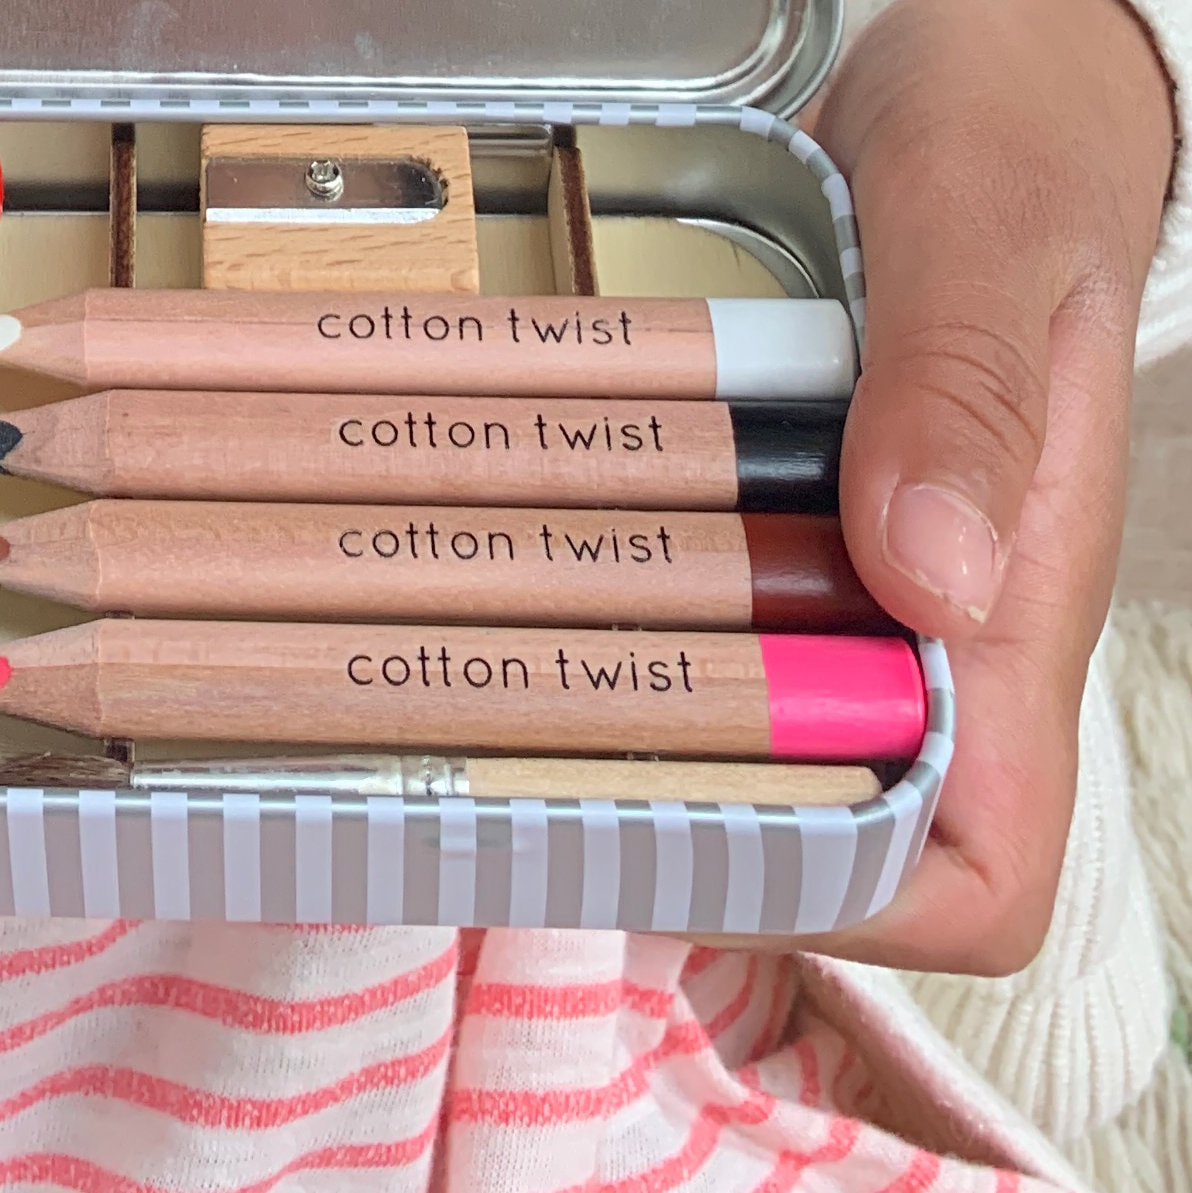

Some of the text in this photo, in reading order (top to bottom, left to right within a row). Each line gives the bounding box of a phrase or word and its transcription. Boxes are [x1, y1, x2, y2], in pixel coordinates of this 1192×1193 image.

[317, 305, 632, 346] cotton twist
[338, 411, 664, 452] cotton twist
[338, 521, 672, 564] cotton twist
[347, 645, 693, 693] cotton twist
